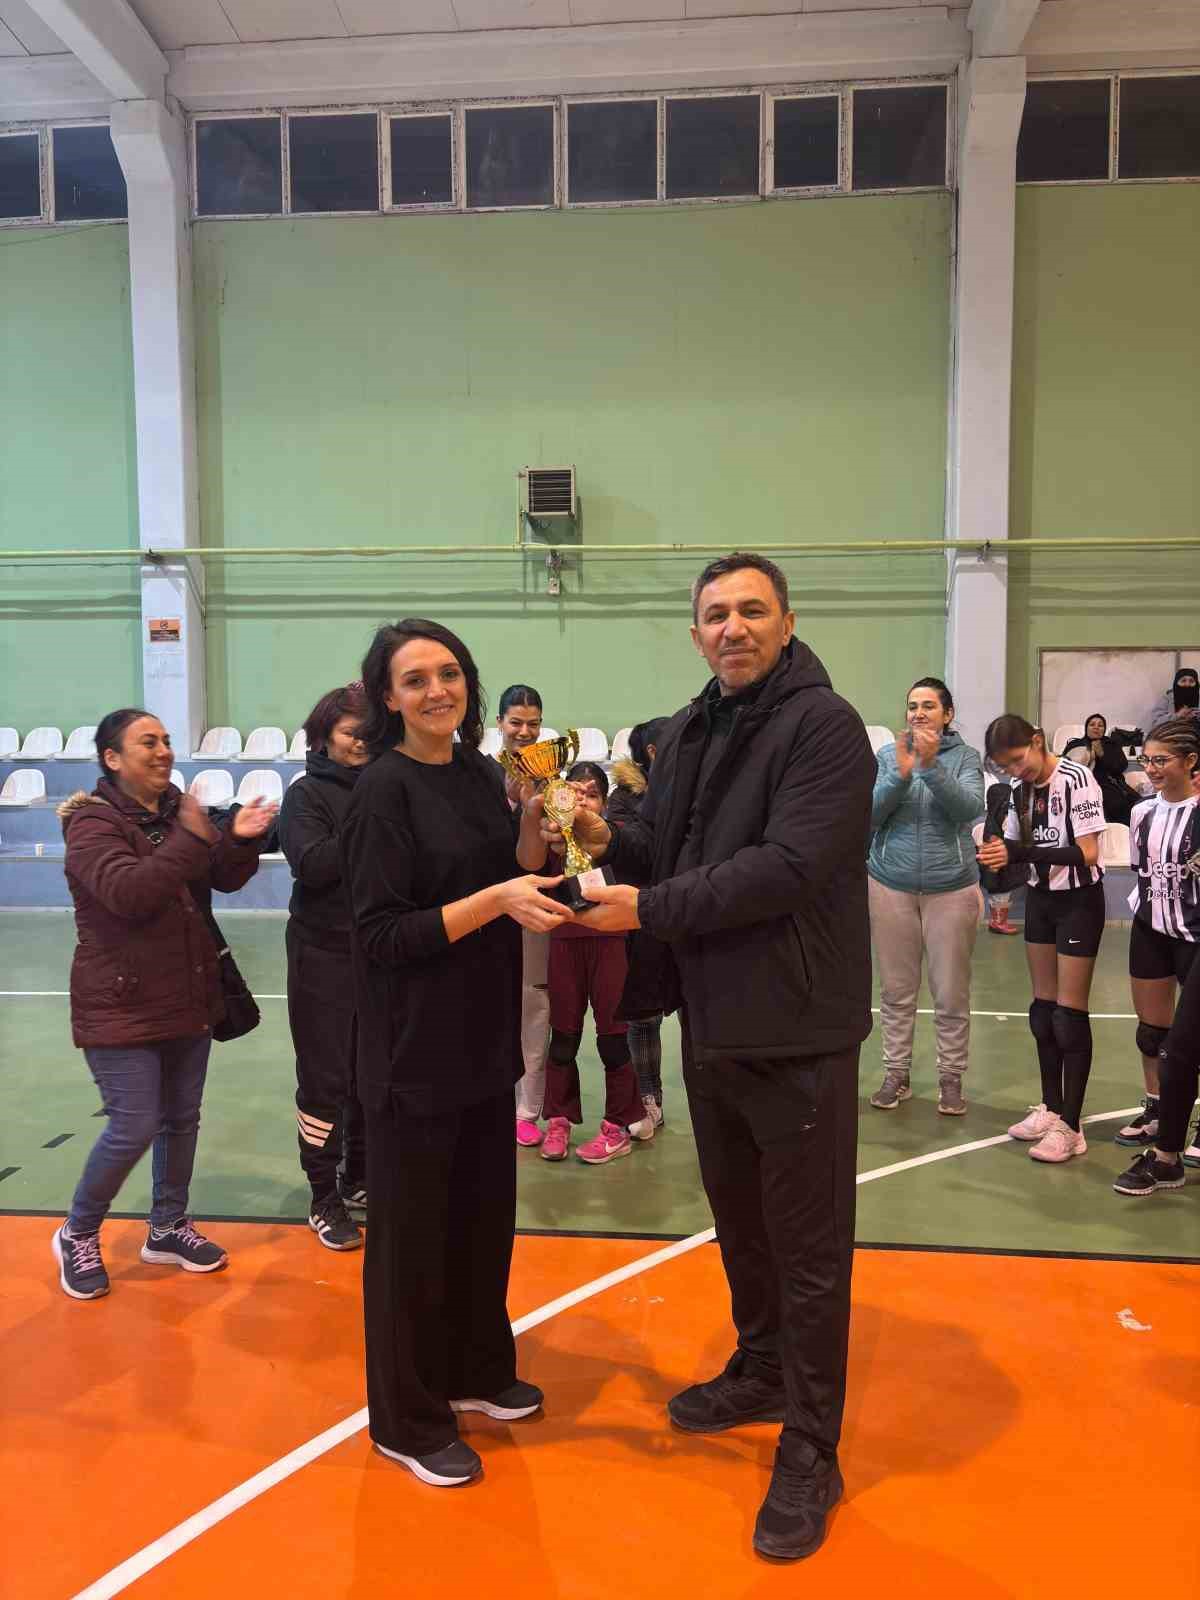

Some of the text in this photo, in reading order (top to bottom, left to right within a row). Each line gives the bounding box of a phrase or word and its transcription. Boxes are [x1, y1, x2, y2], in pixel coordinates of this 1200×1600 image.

[1079, 810, 1099, 820] COM
[1033, 825, 1059, 841] eko
[1139, 855, 1190, 882] Jeep
